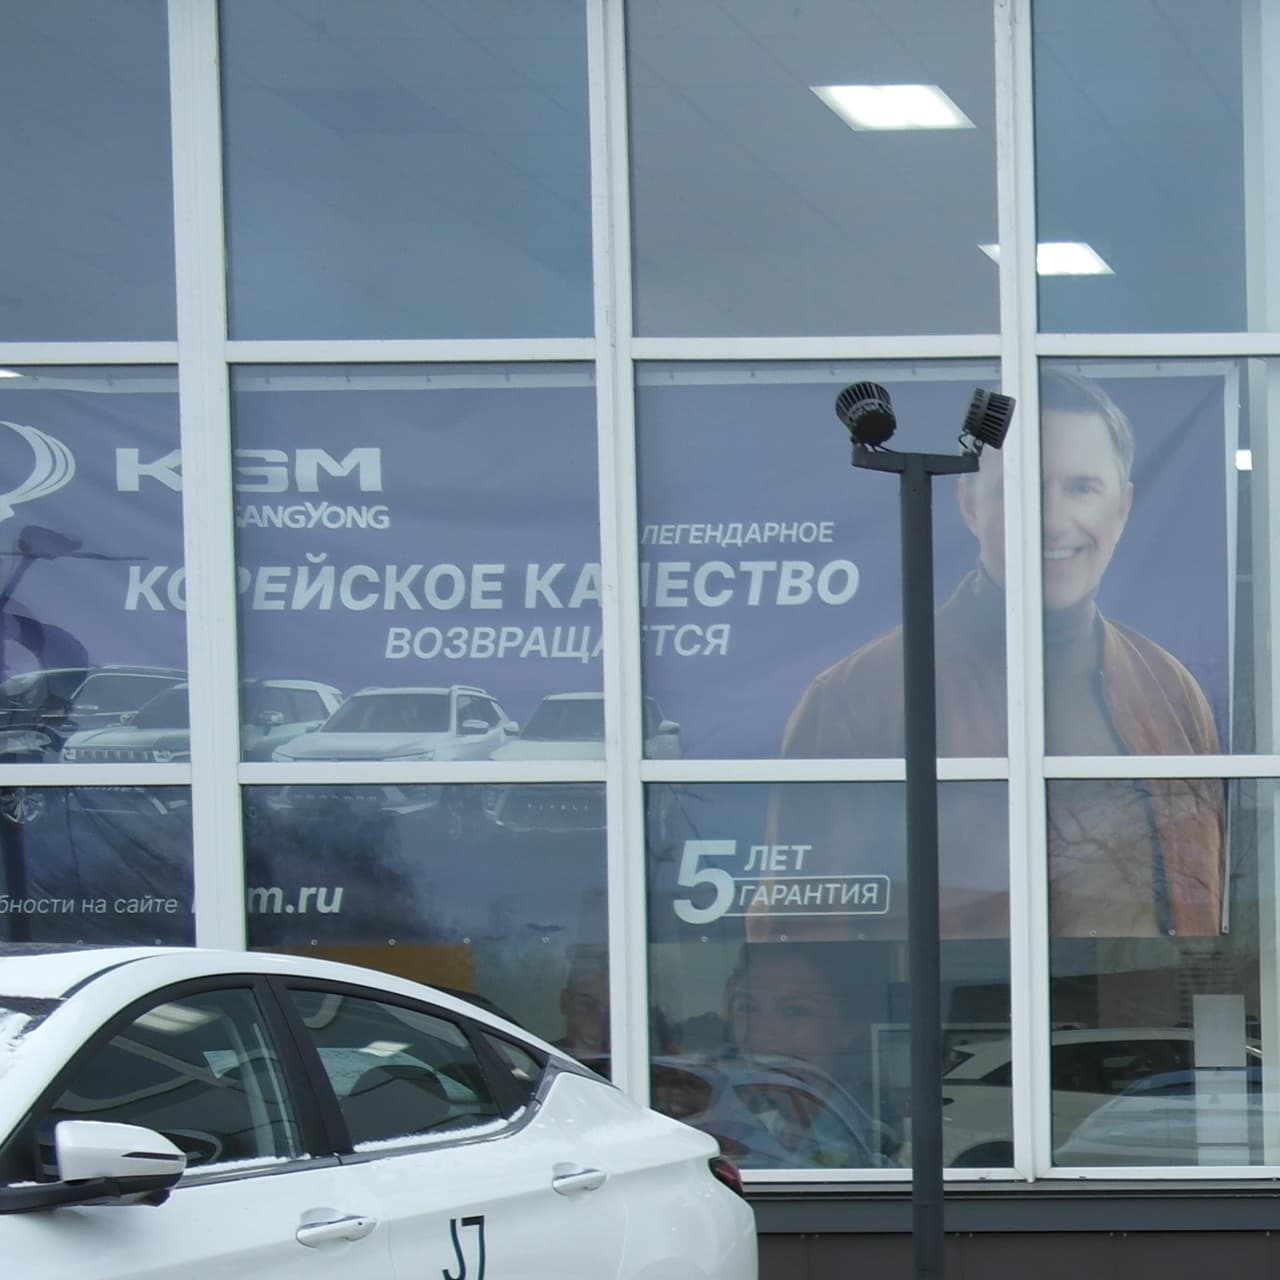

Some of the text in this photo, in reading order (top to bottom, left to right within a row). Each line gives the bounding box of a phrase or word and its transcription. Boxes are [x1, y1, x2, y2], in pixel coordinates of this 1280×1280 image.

[236, 502, 390, 529] ANGYONG
[641, 521, 834, 548] ЛЕГЕНДАРНОЕ
[384, 623, 731, 664] ВОЗВРАЩТСЯ
[673, 840, 813, 925] 5 ЛЕТ
[738, 882, 879, 907] ГАРАНТИЯ
[81, 898, 108, 914] на
[113, 894, 178, 914] сайте
